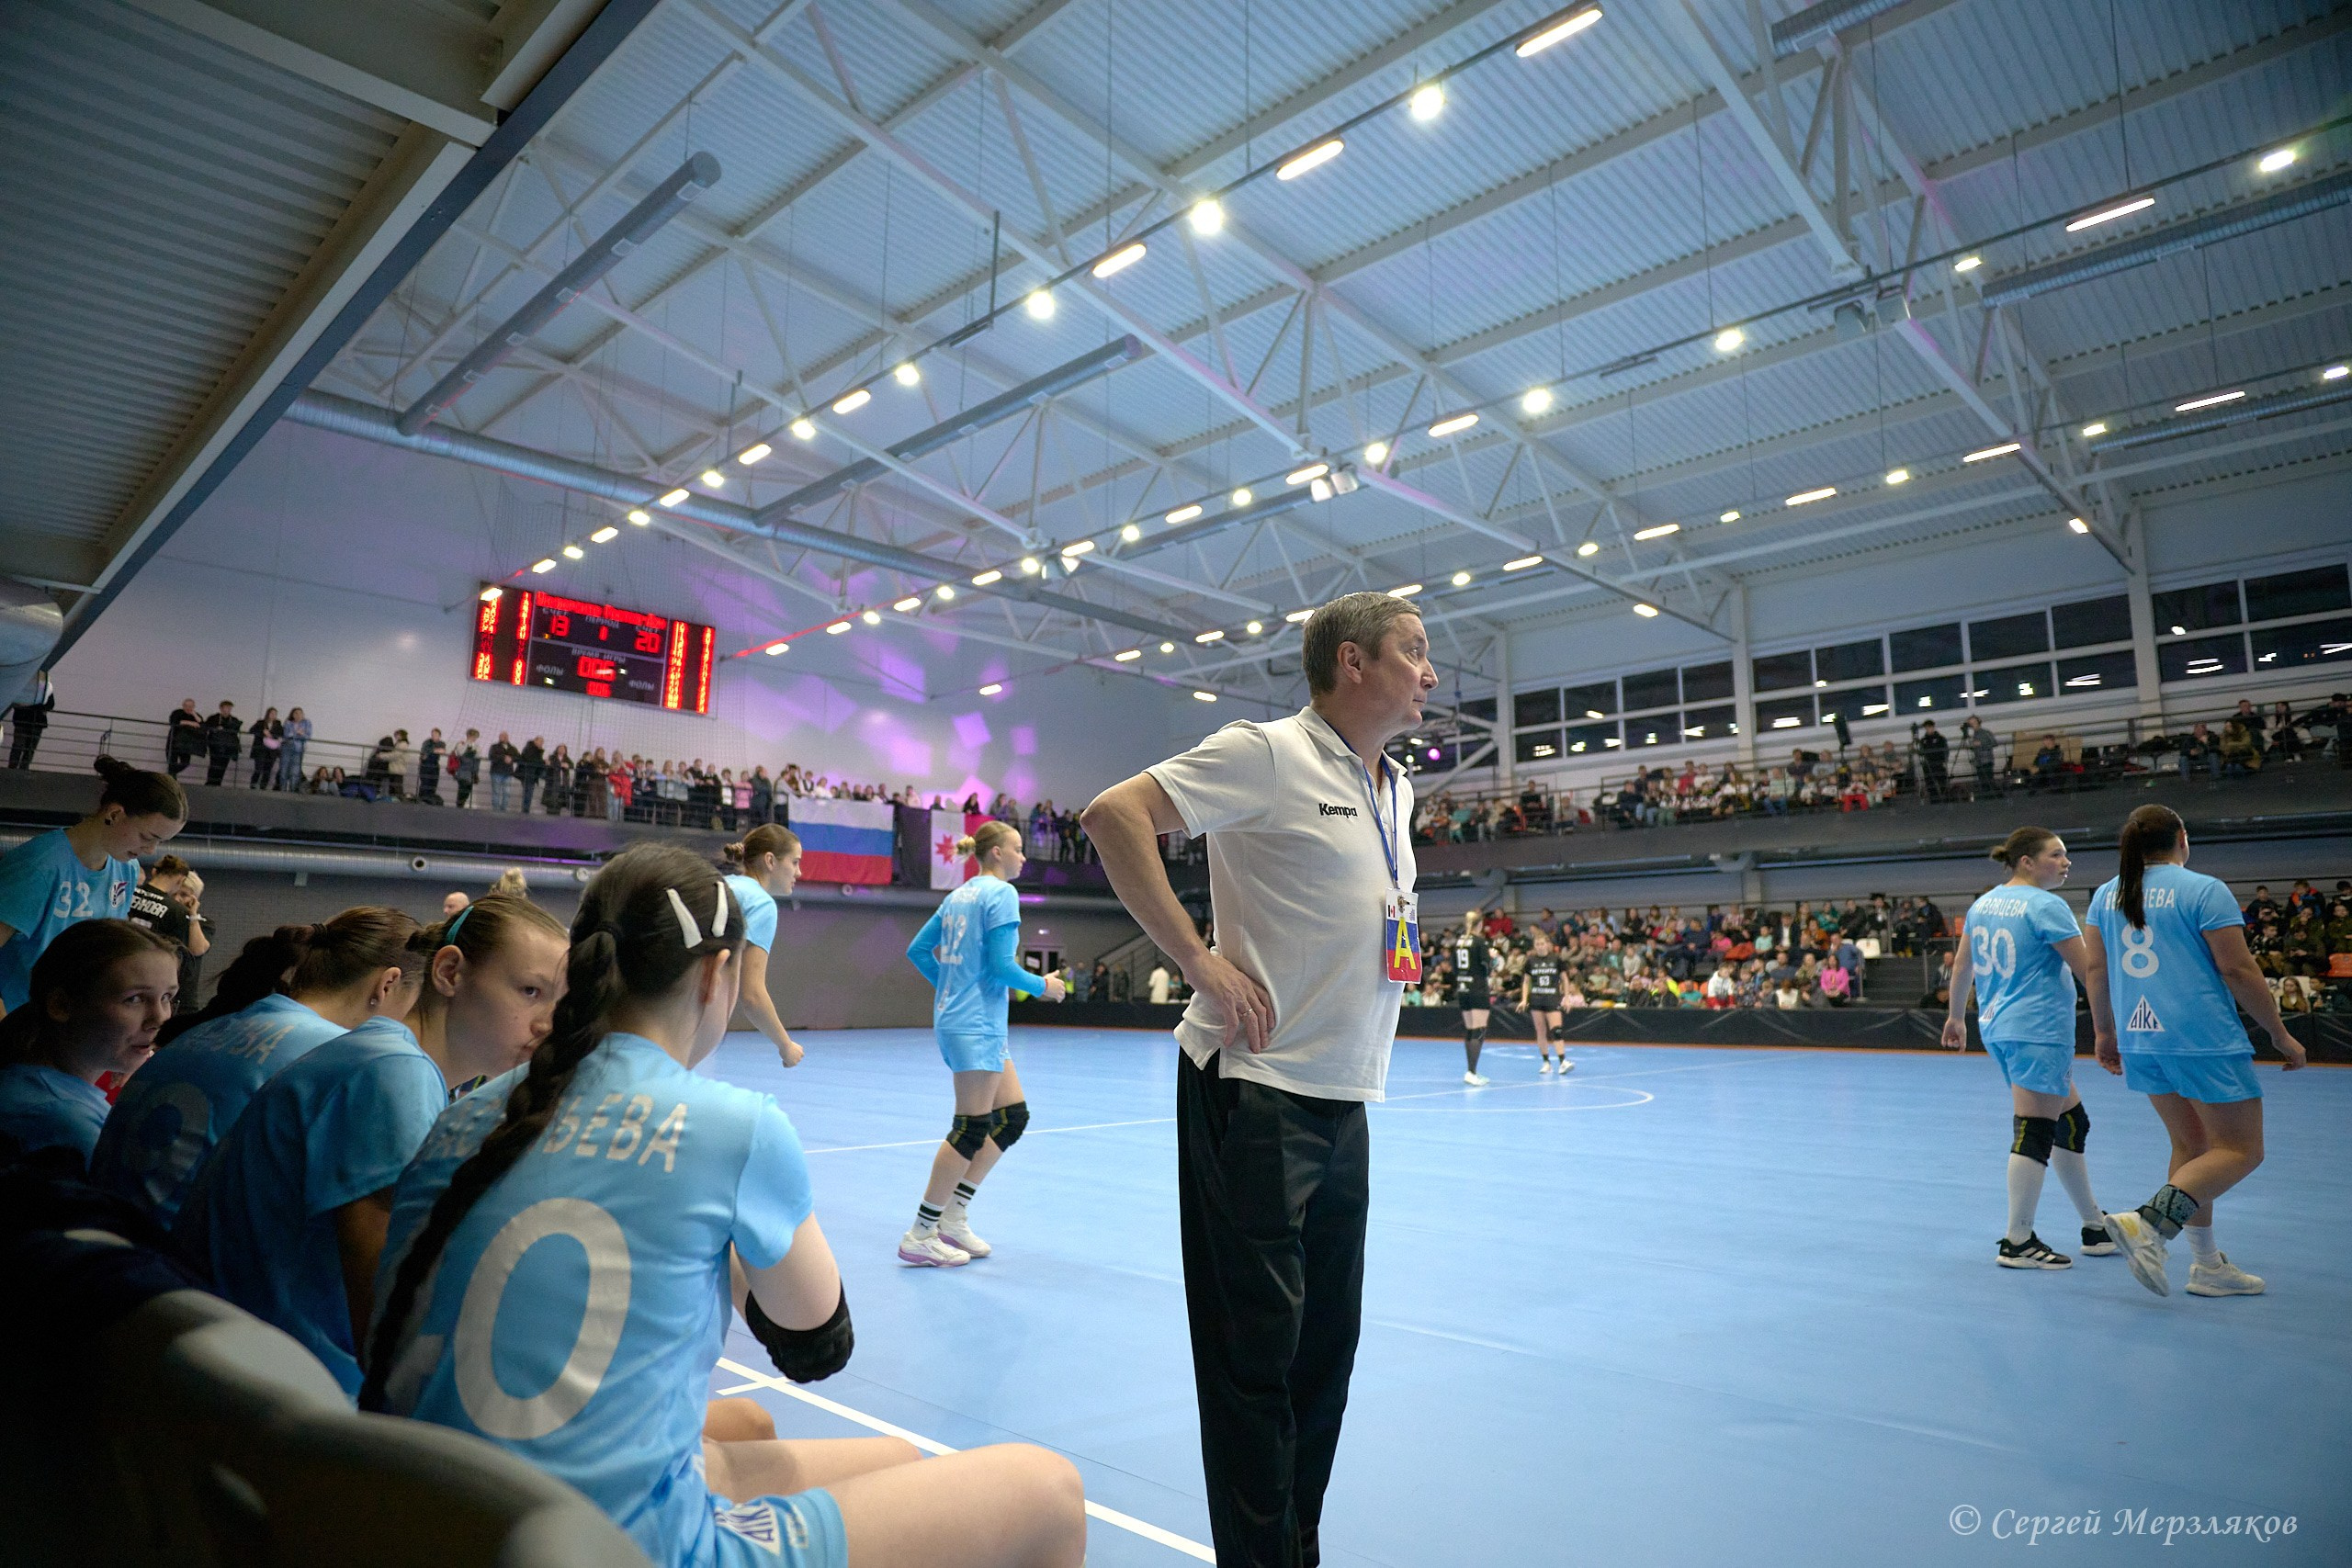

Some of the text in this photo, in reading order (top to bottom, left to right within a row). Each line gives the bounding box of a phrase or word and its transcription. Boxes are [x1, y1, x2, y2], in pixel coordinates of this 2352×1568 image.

[550, 615, 570, 637] 13
[634, 630, 661, 653] 20
[1318, 803, 1358, 818] Kempa
[53, 881, 94, 919] 32
[1456, 948, 1470, 969] 19
[1973, 925, 2017, 979] 30
[2121, 924, 2159, 979] 8
